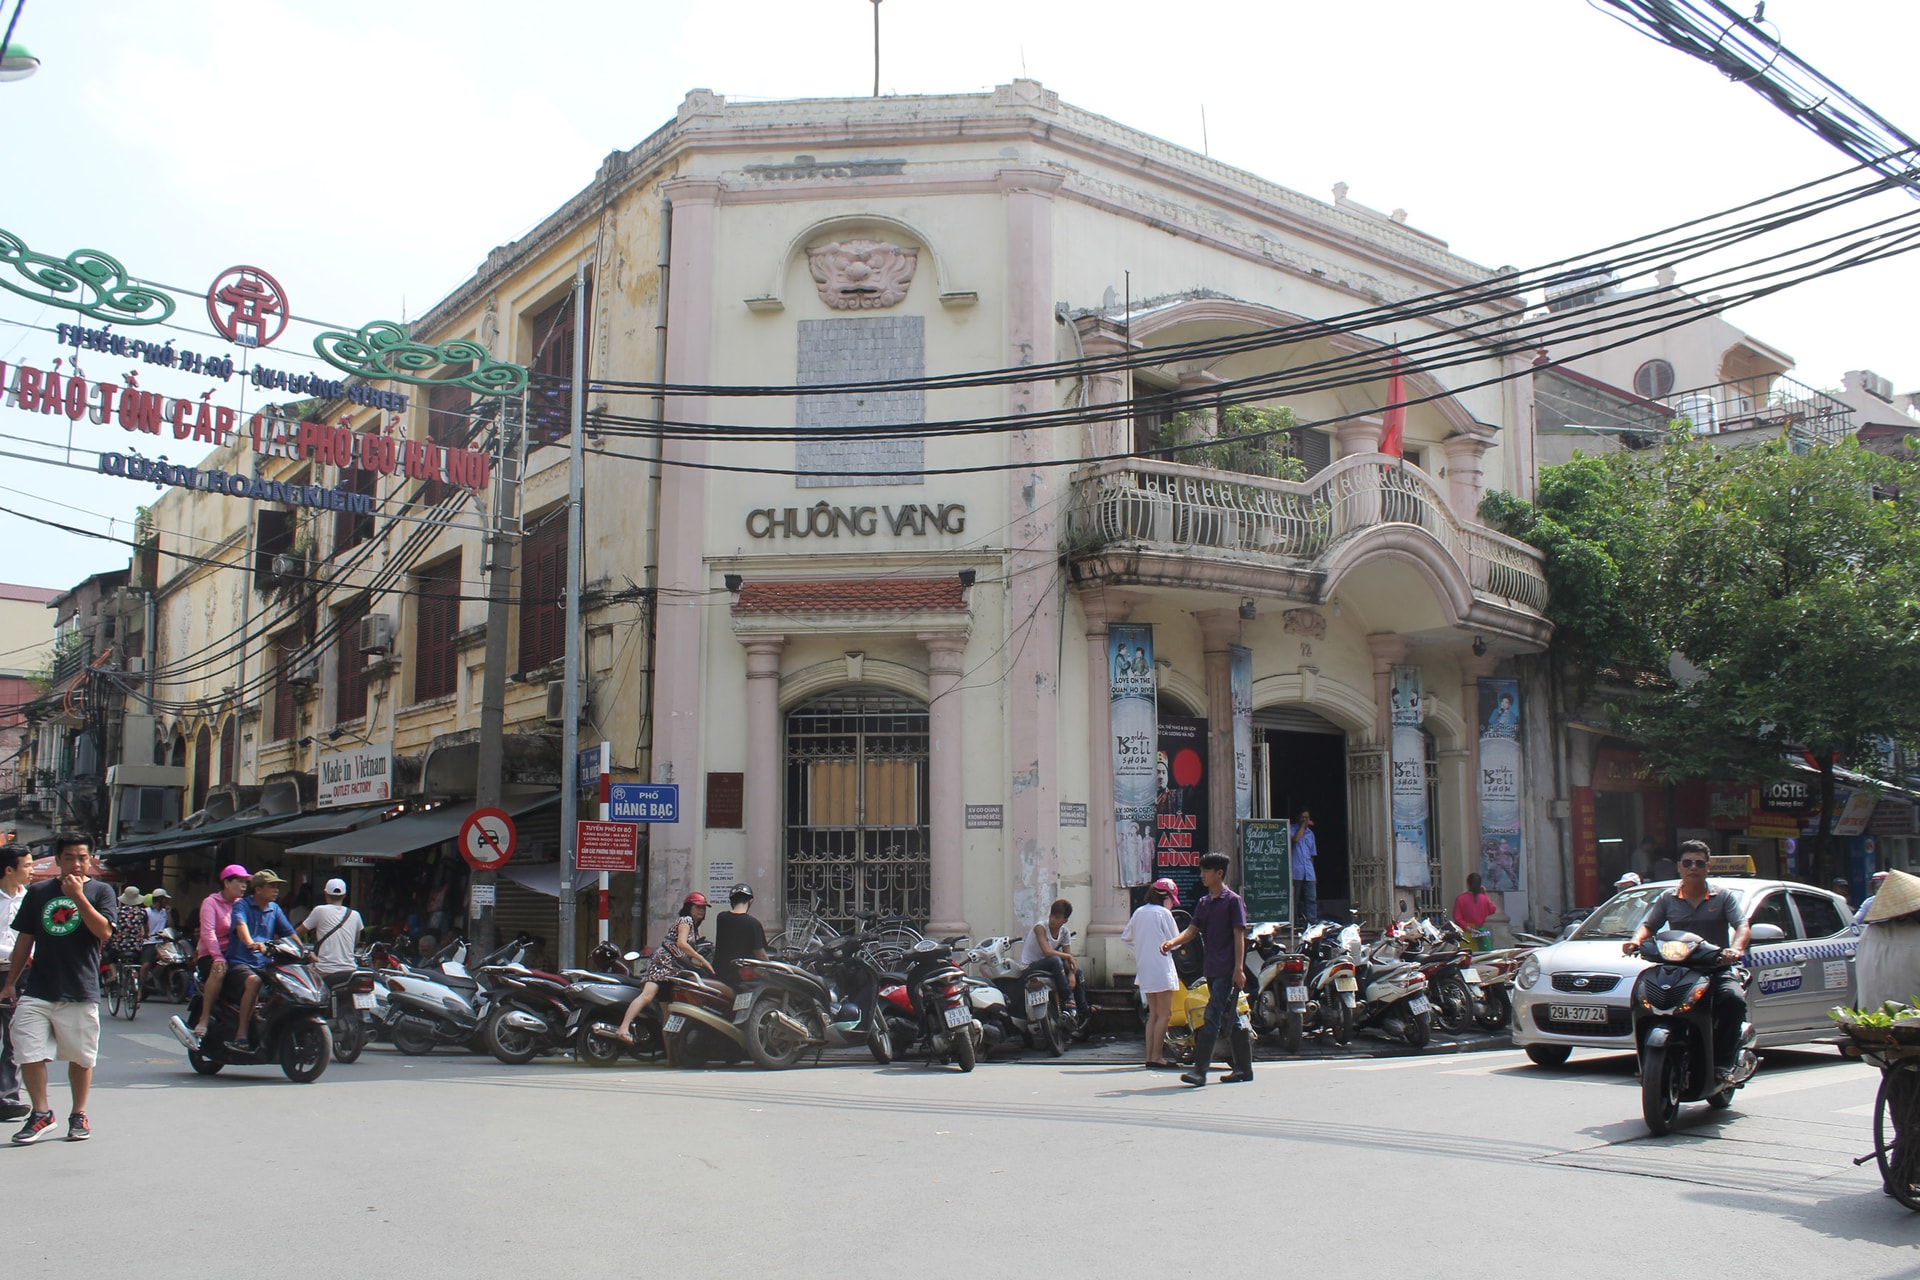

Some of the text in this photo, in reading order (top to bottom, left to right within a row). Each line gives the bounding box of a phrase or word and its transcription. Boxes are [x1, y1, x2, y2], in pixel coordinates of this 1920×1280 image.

[349, 383, 410, 414] STREET
[300, 414, 352, 469] PHỐ
[404, 434, 441, 482] HÀ
[449, 441, 490, 496] NỘI
[746, 500, 966, 539] CHUÔNG VÀNG
[1116, 735, 1151, 755] Bell
[322, 754, 386, 785] Made in Vietnam
[1122, 756, 1148, 765] SHOW
[1483, 768, 1514, 785] Bell
[333, 783, 351, 798] OUTLET
[351, 780, 372, 795] FACTORY
[639, 790, 660, 800] PHỐ
[615, 800, 673, 819] HÀNG BẠC
[1157, 810, 1197, 832] LUẬN
[1157, 831, 1192, 848] ANH
[1157, 848, 1200, 867] HÙNG
[43, 901, 58, 919] FOOT
